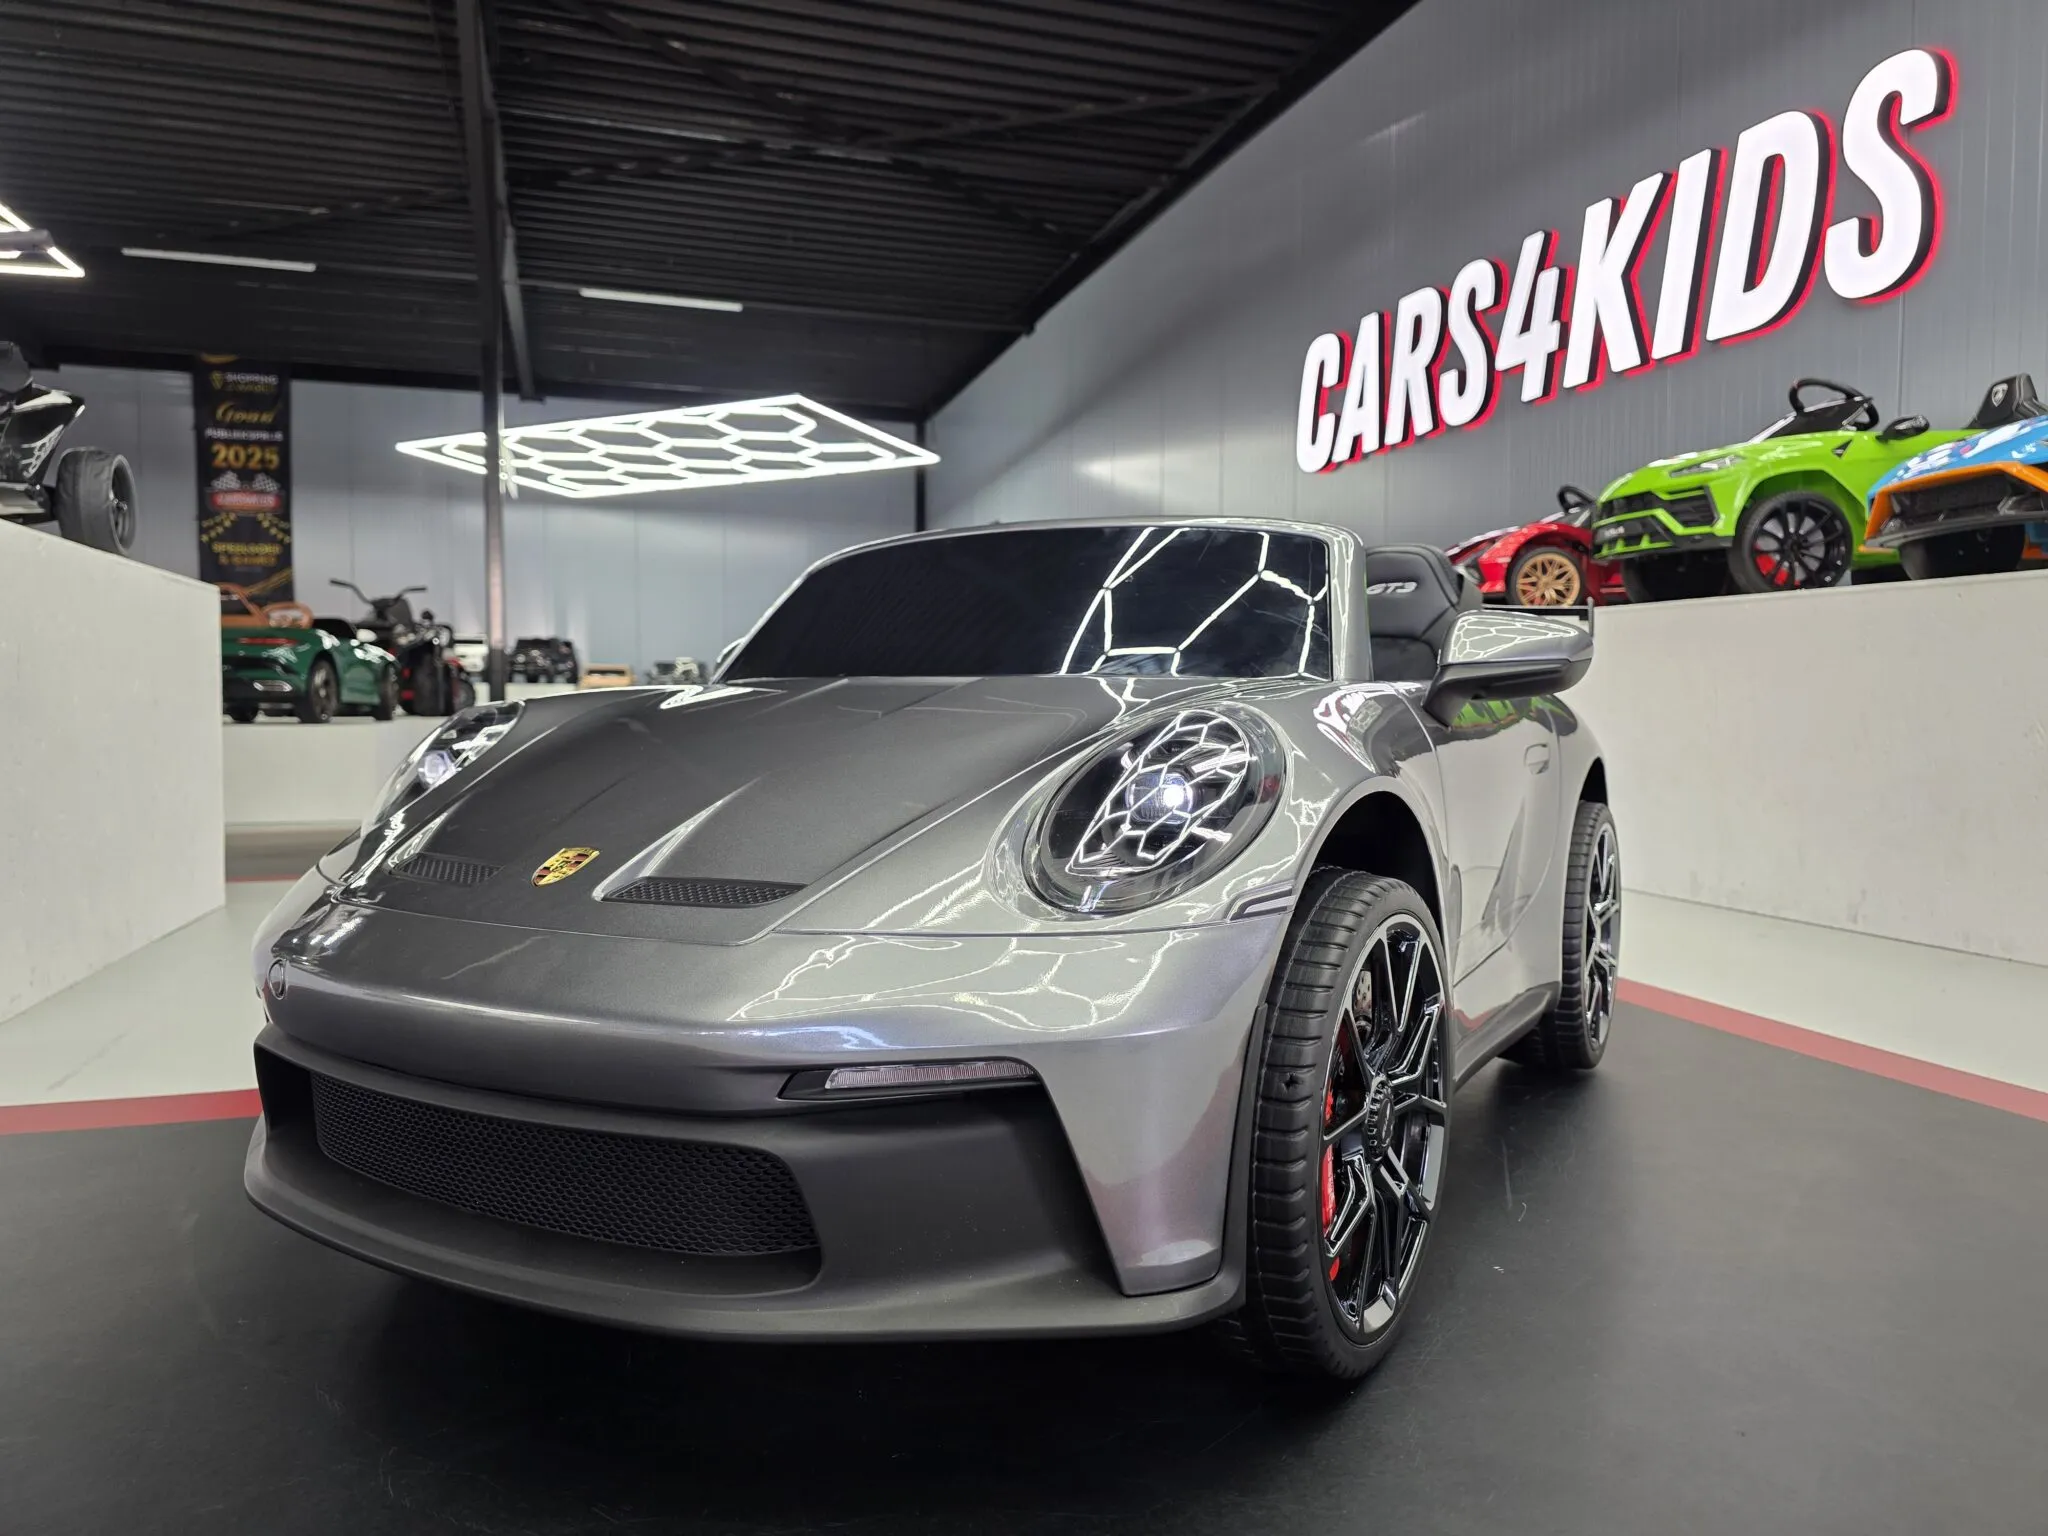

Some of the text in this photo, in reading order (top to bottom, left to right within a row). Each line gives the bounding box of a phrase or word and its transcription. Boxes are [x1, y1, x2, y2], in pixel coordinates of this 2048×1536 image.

[1297, 48, 1948, 474] CARS4KIDS
[211, 442, 280, 470] 2025
[1366, 581, 1418, 595] GT3
